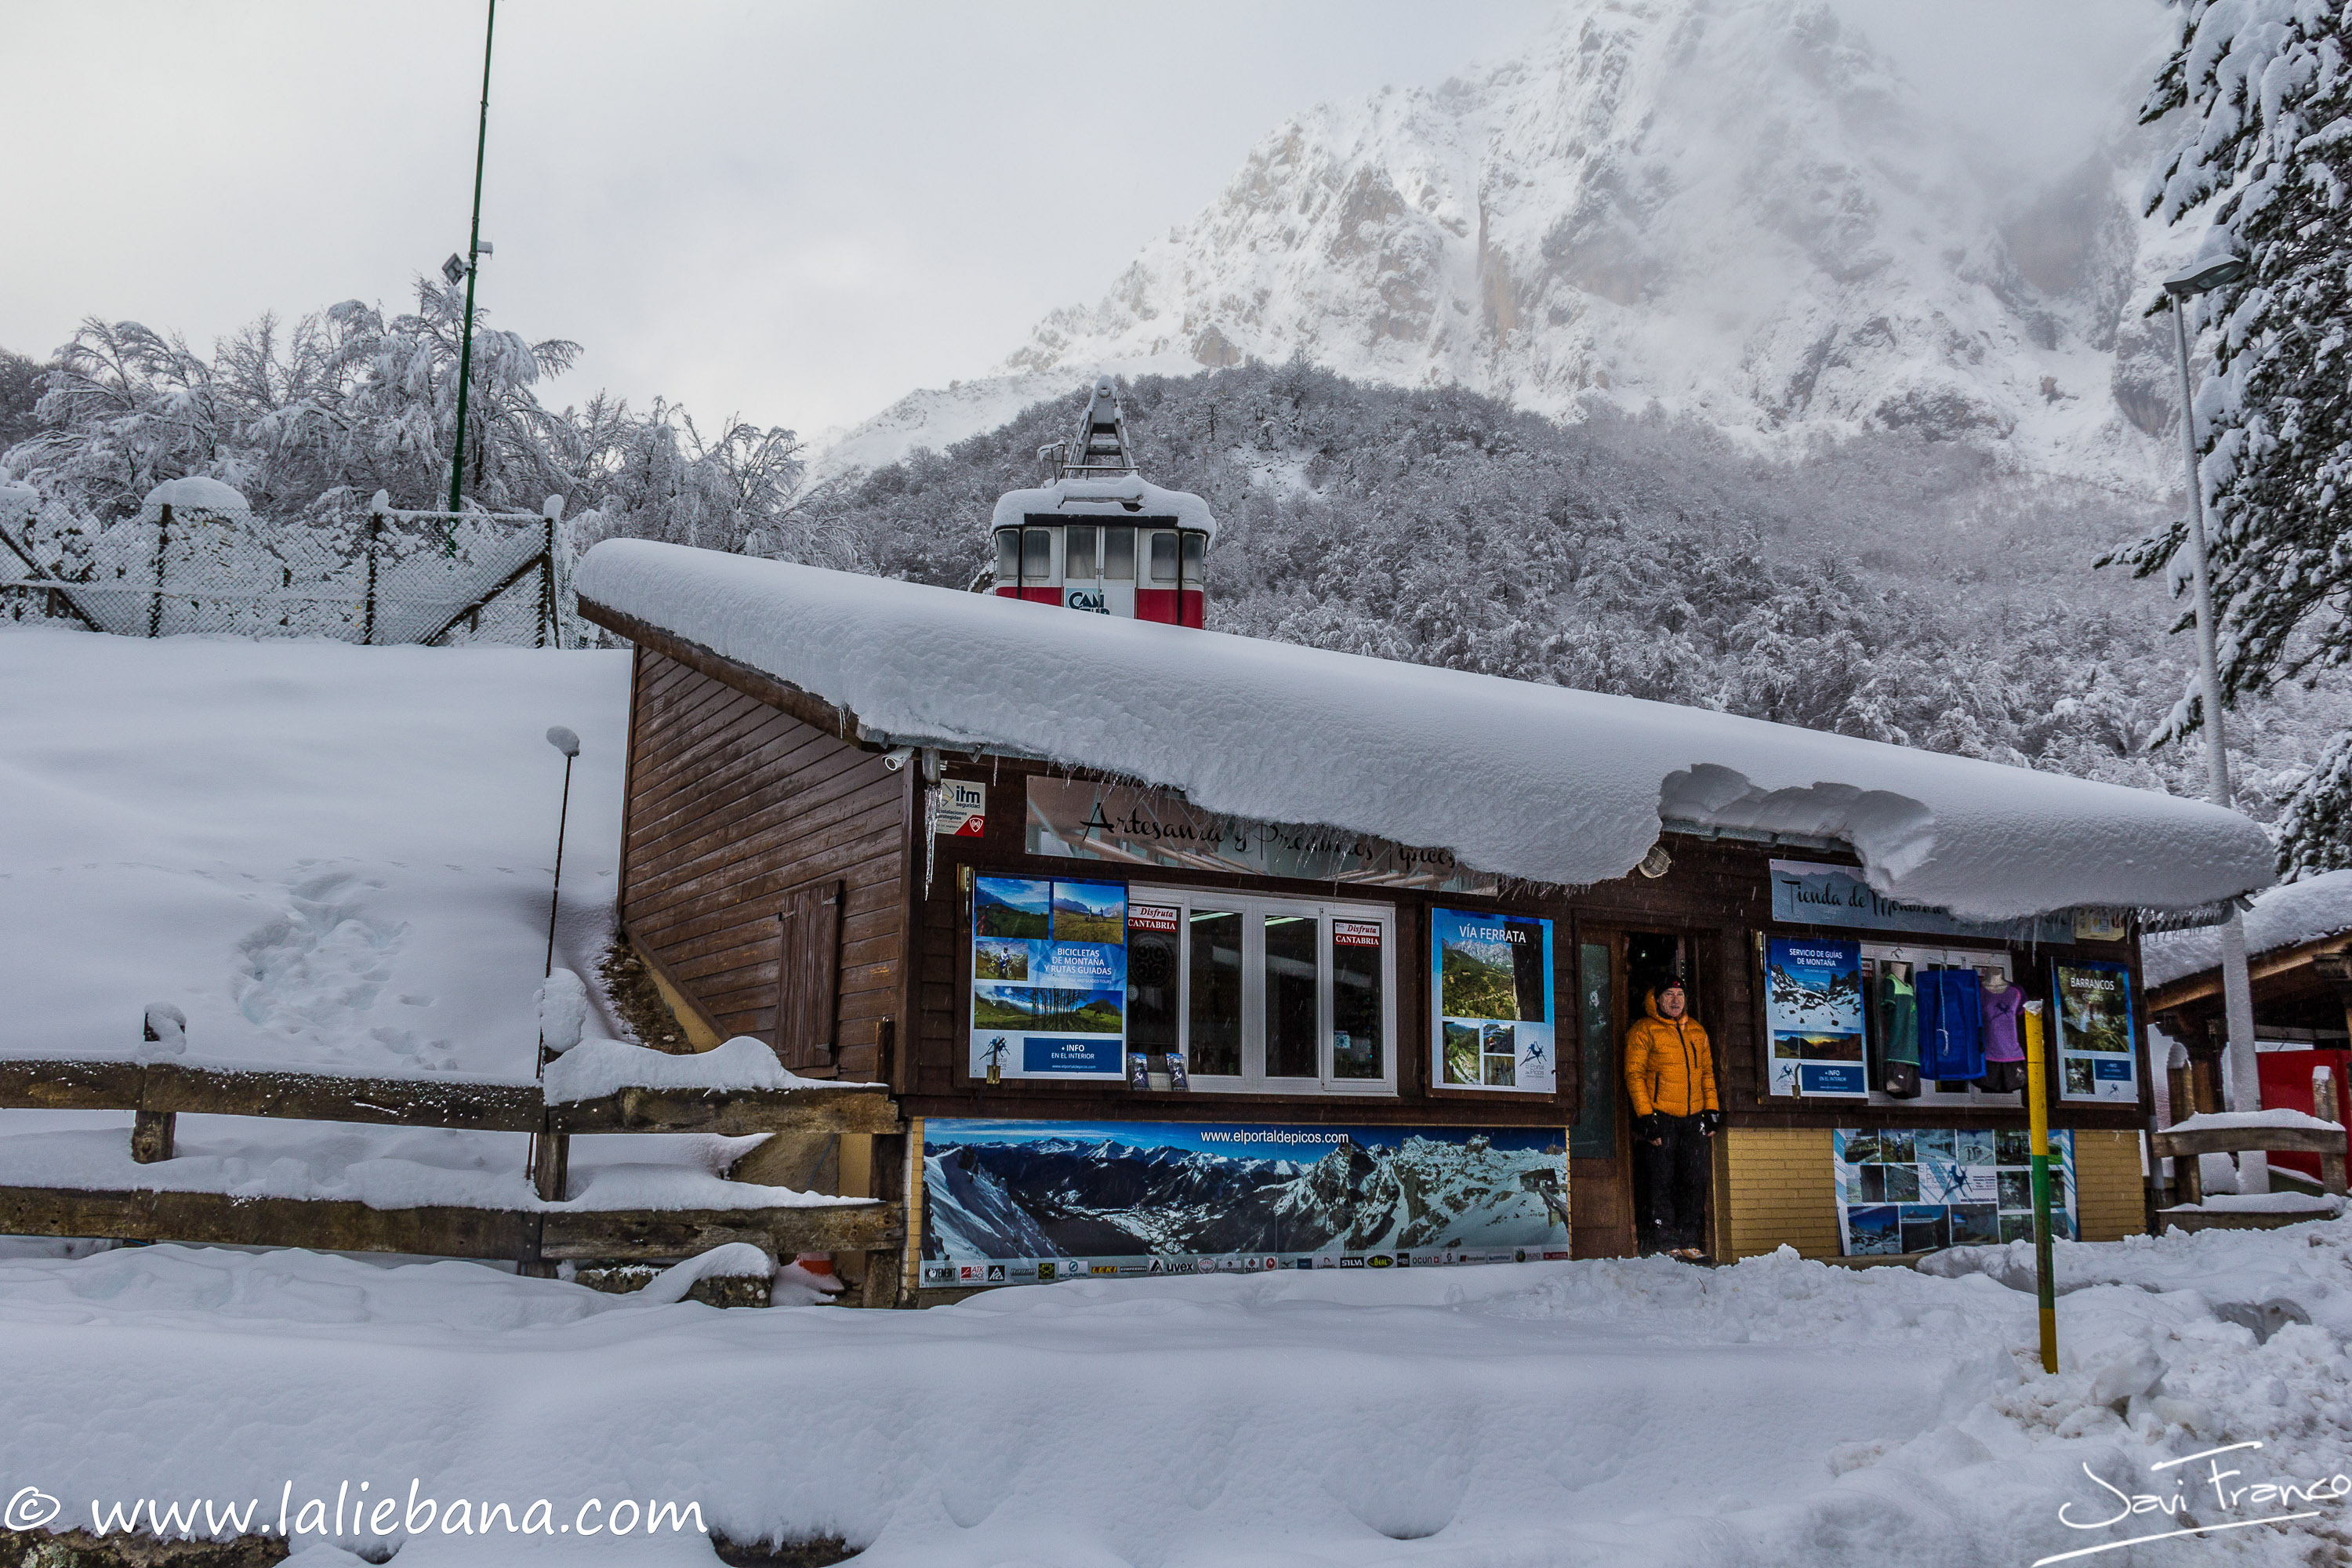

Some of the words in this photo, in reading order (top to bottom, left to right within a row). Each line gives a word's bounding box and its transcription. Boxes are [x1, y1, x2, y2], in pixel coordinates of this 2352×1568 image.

[1068, 591, 1105, 609] CAN
[956, 785, 981, 804] itm
[1780, 879, 1842, 914] Tienda
[1848, 885, 1866, 909] de
[1140, 907, 1174, 918] Disfruta
[1128, 919, 1176, 931] CANTABRIA
[1347, 924, 1377, 935] Disfruta
[1459, 923, 1478, 939] VÍA
[1480, 927, 1526, 943] FERRATA
[1335, 935, 1379, 946] CANTABRIA
[1057, 948, 1100, 957] BICICLETAS
[1789, 948, 1816, 956] SERVICIO
[1824, 949, 1843, 959] GUÍAS
[1064, 956, 1105, 966] MONTAÑA
[1806, 958, 1836, 967] MONTAÑA
[1051, 965, 1076, 974] RUTAS
[1077, 966, 1112, 975] GUIADAS
[2071, 977, 2114, 990] BARRANCOS
[1200, 1129, 1349, 1145] www.elportaldepicos.com
[1167, 1262, 1193, 1272] uvex
[1374, 1257, 1388, 1266] BEAL
